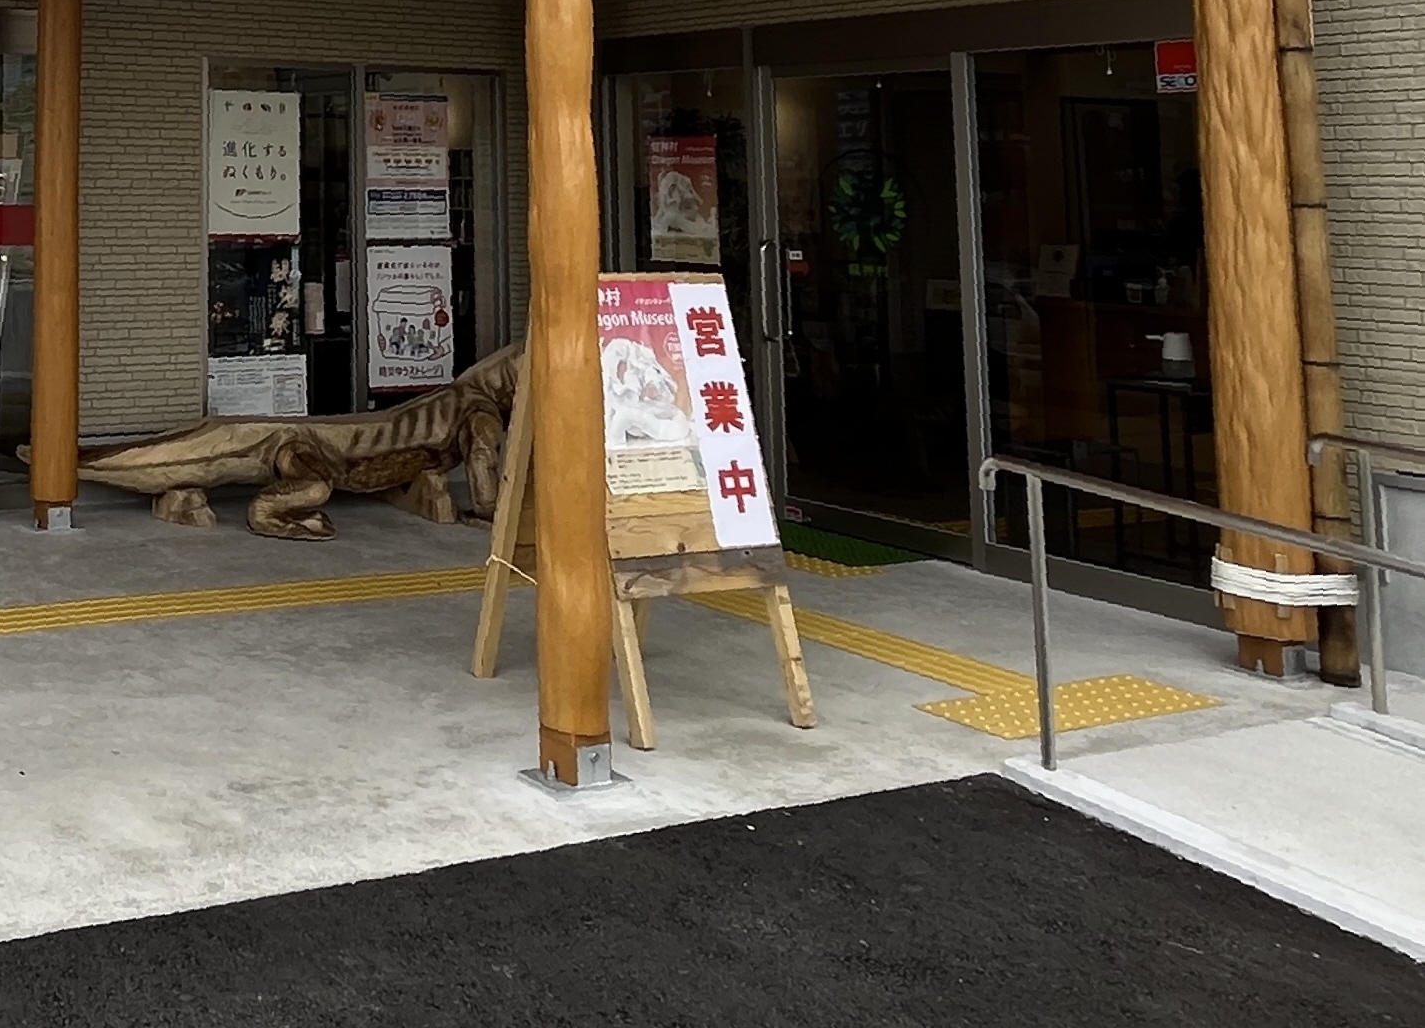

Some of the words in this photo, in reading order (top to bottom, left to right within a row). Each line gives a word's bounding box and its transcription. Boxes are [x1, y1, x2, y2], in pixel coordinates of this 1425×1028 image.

[1159, 75, 1197, 87] SECO
[222, 140, 287, 157] 進化する
[630, 309, 673, 326] Museu
[686, 305, 757, 514] 営業中
